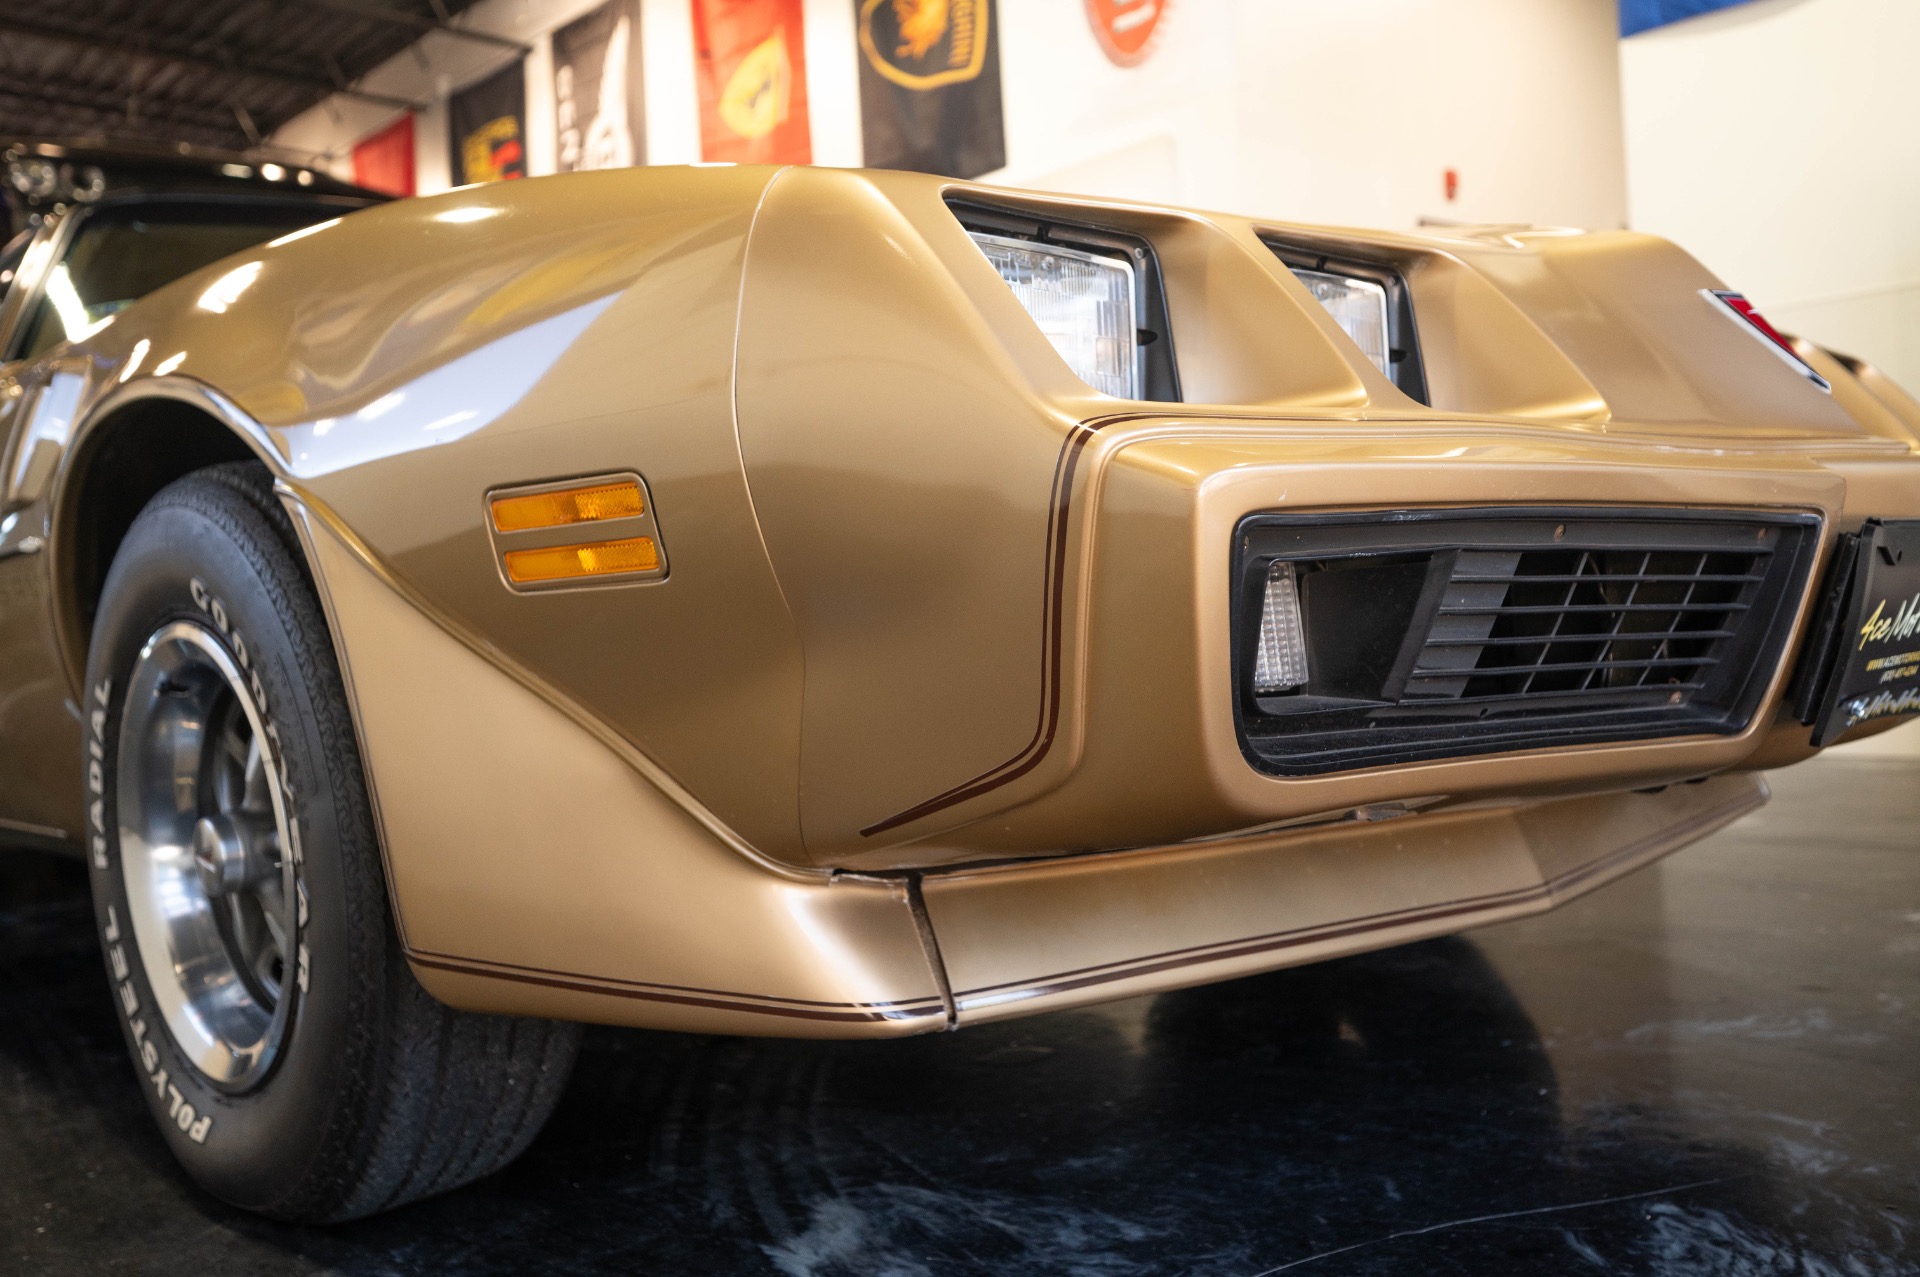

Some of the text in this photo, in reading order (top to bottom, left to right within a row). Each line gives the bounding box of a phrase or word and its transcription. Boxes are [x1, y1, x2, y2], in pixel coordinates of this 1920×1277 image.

[1858, 592, 1920, 651] Ace Mot
[89, 678, 213, 1144] POLYSTEEL RADIAL
